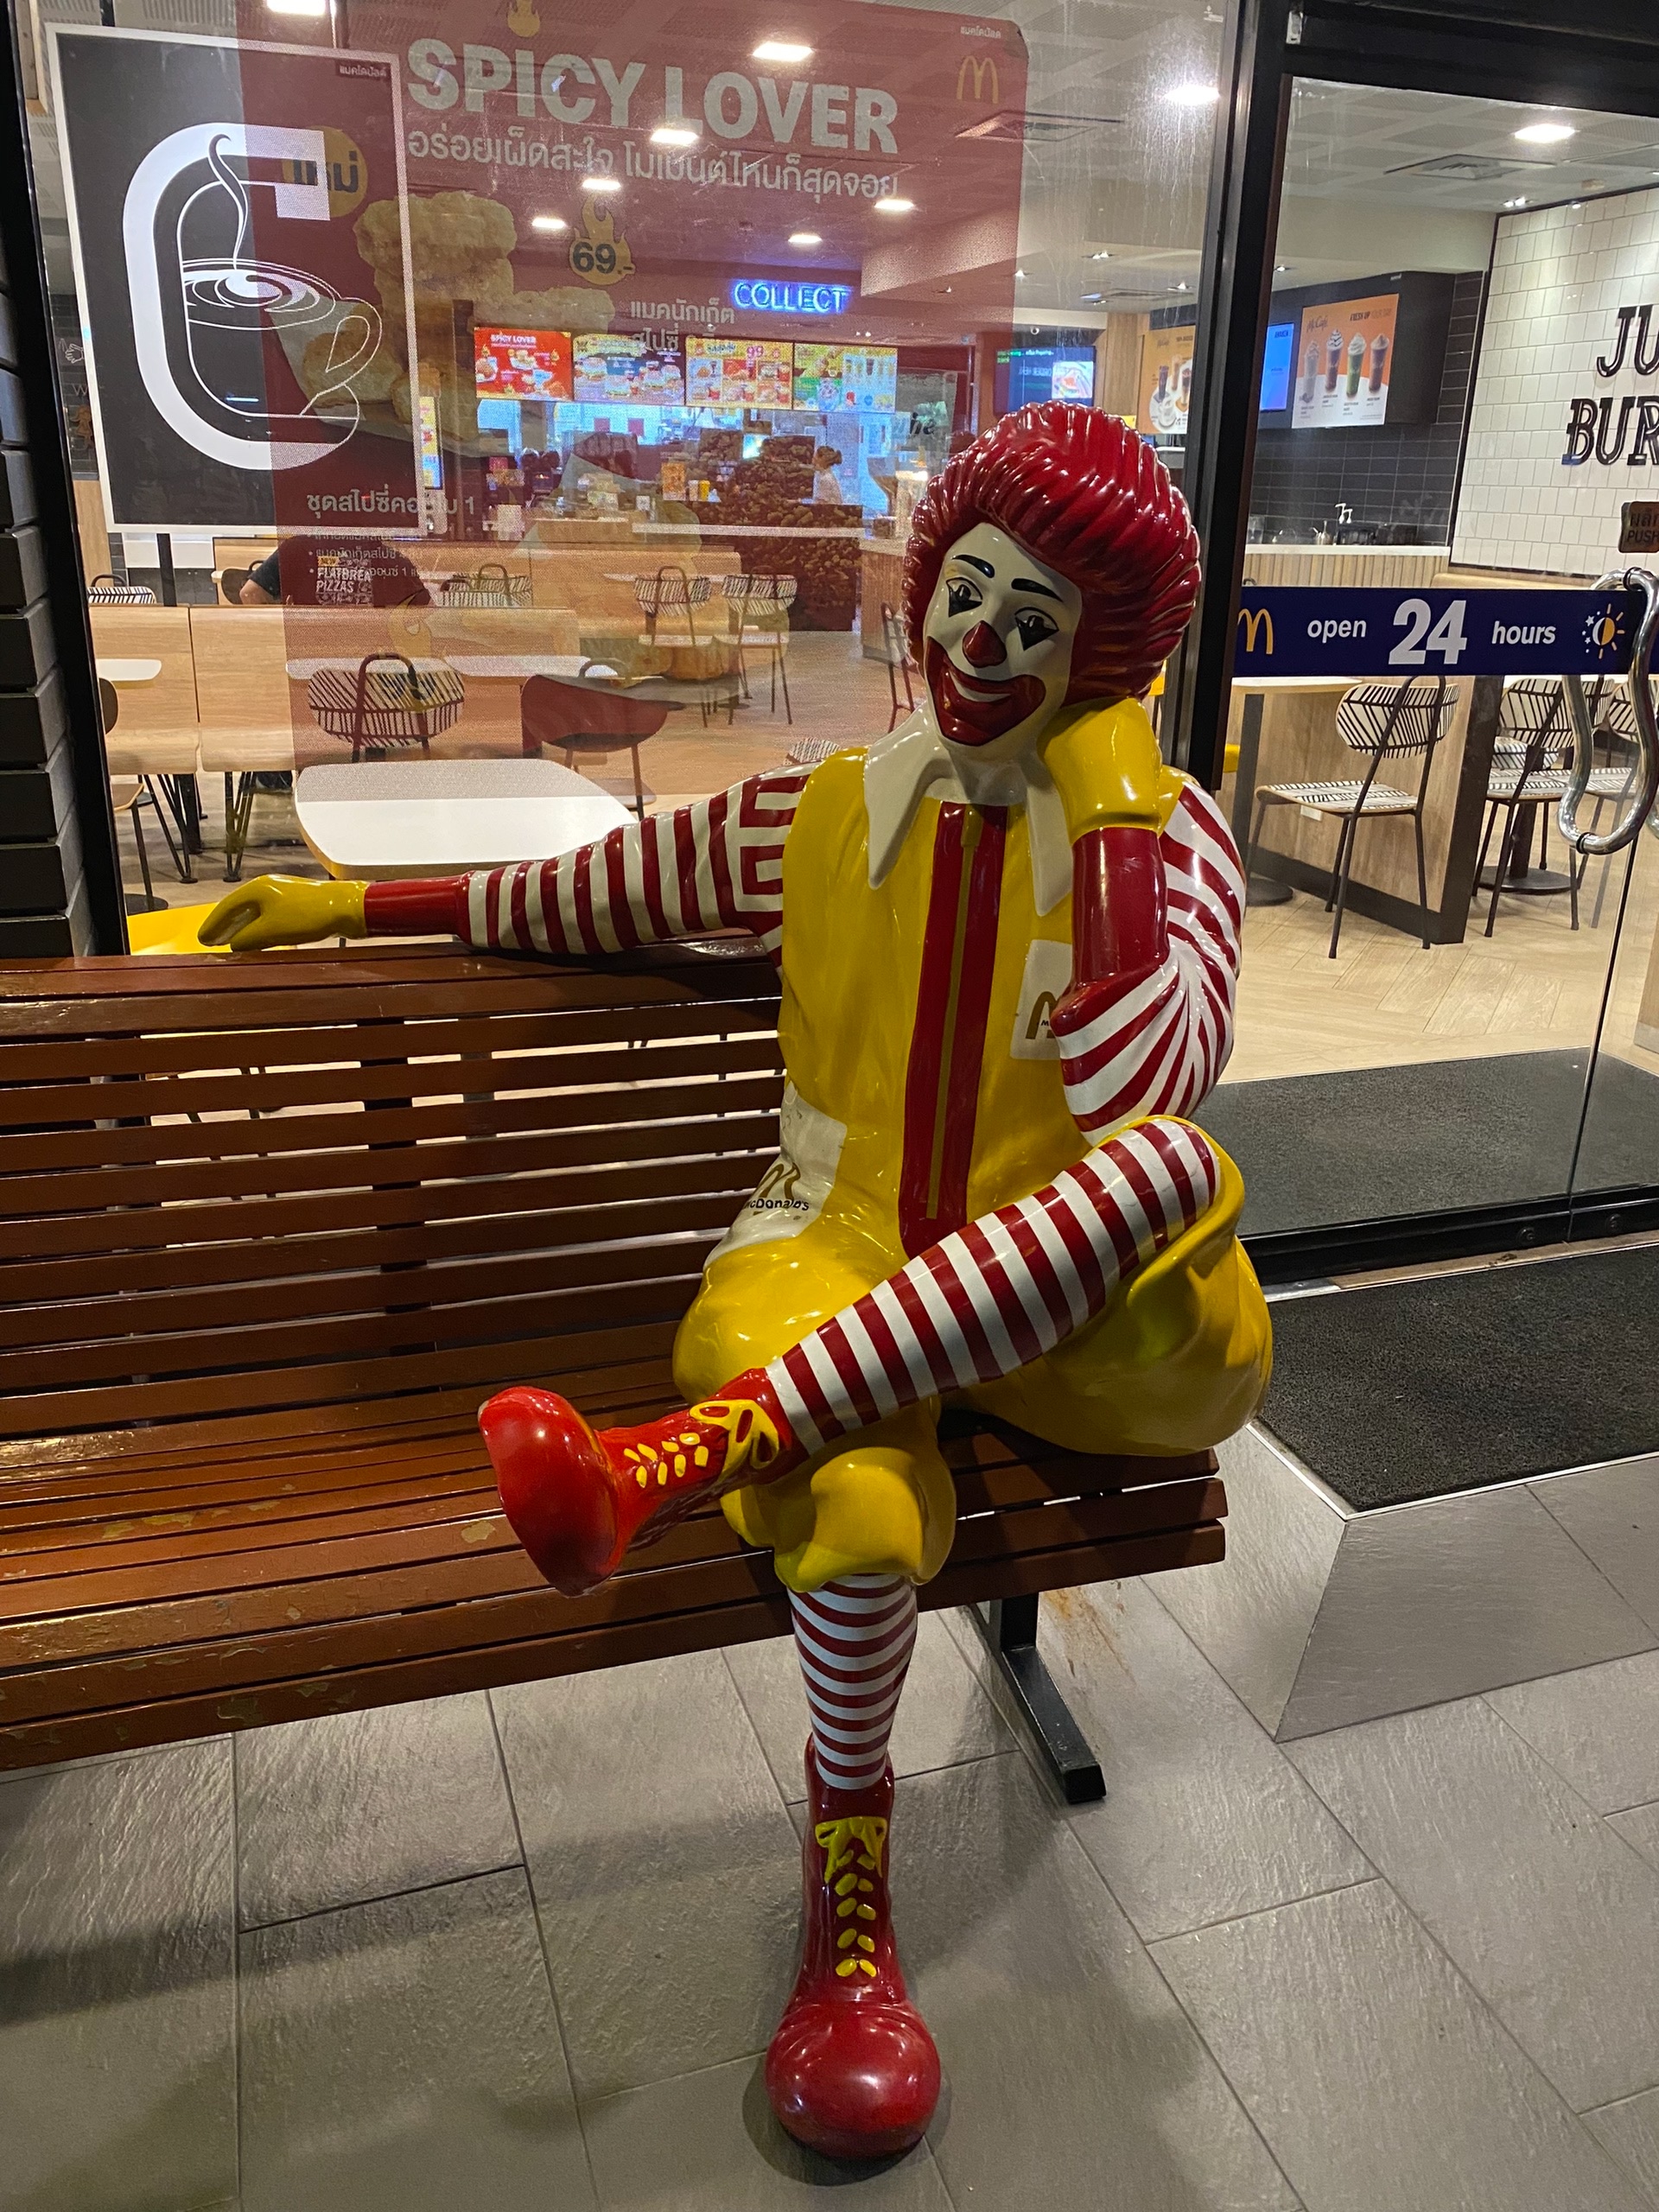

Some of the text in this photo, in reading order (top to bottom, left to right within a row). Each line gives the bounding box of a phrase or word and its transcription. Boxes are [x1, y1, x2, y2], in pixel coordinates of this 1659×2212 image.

[407, 37, 898, 155] SPICY LOVER
[630, 296, 735, 325] แมคนักเก็ต
[734, 281, 849, 314] COLLECT
[315, 579, 355, 594] PIZZAS
[1306, 618, 1367, 644] open
[1388, 597, 1468, 665] 24
[1491, 620, 1556, 645] hours
